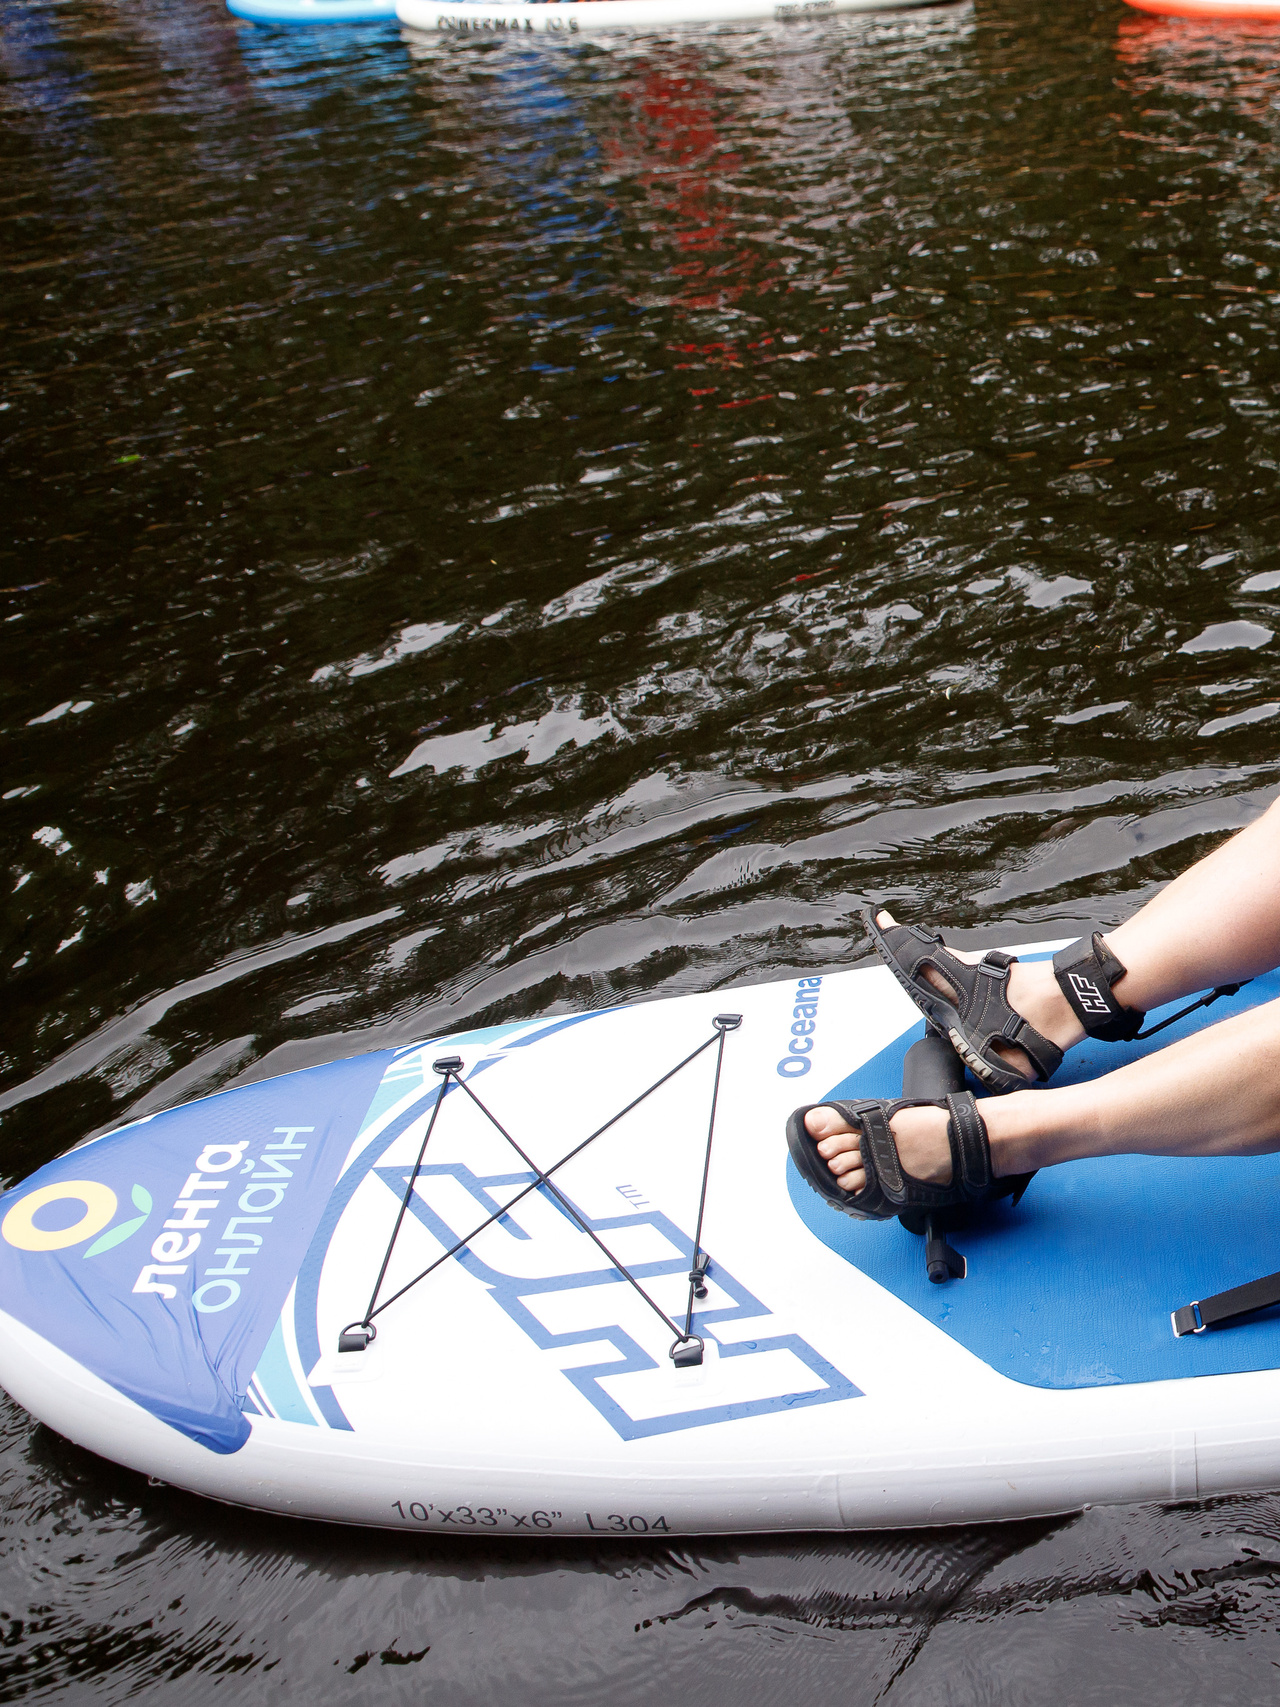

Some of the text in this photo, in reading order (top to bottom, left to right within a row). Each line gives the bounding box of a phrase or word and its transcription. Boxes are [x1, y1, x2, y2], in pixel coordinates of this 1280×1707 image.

[776, 976, 823, 1078] Oceana
[131, 1140, 250, 1299] лента
[585, 1511, 672, 1533] L304
